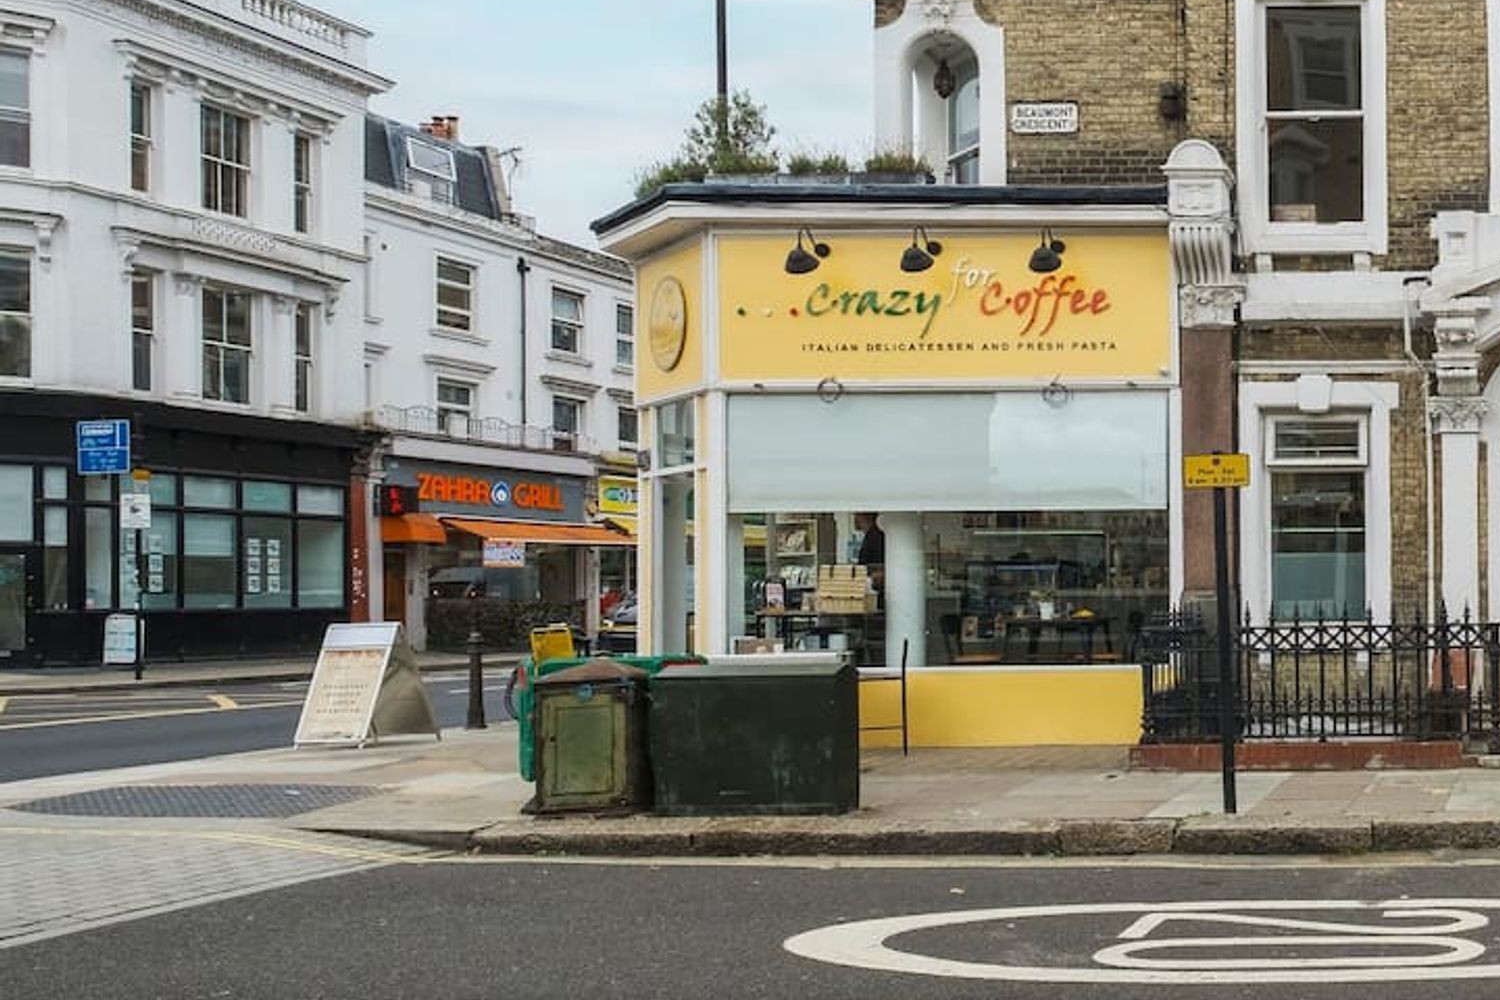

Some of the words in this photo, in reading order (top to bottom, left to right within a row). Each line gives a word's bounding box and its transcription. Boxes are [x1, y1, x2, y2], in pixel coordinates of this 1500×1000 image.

[1016, 106, 1074, 117] BEAUMONT
[1014, 119, 1068, 130] CRESCENT
[947, 254, 996, 307] for
[978, 274, 1112, 337] Coffee
[801, 342, 859, 352] ITALIAN
[866, 342, 974, 352] DELICATESSEN
[981, 342, 1010, 351] AND
[1016, 341, 1064, 351] FRESH
[1071, 341, 1118, 351] PASTA
[416, 473, 491, 505] ZAHRA
[513, 482, 565, 512] GRILL
